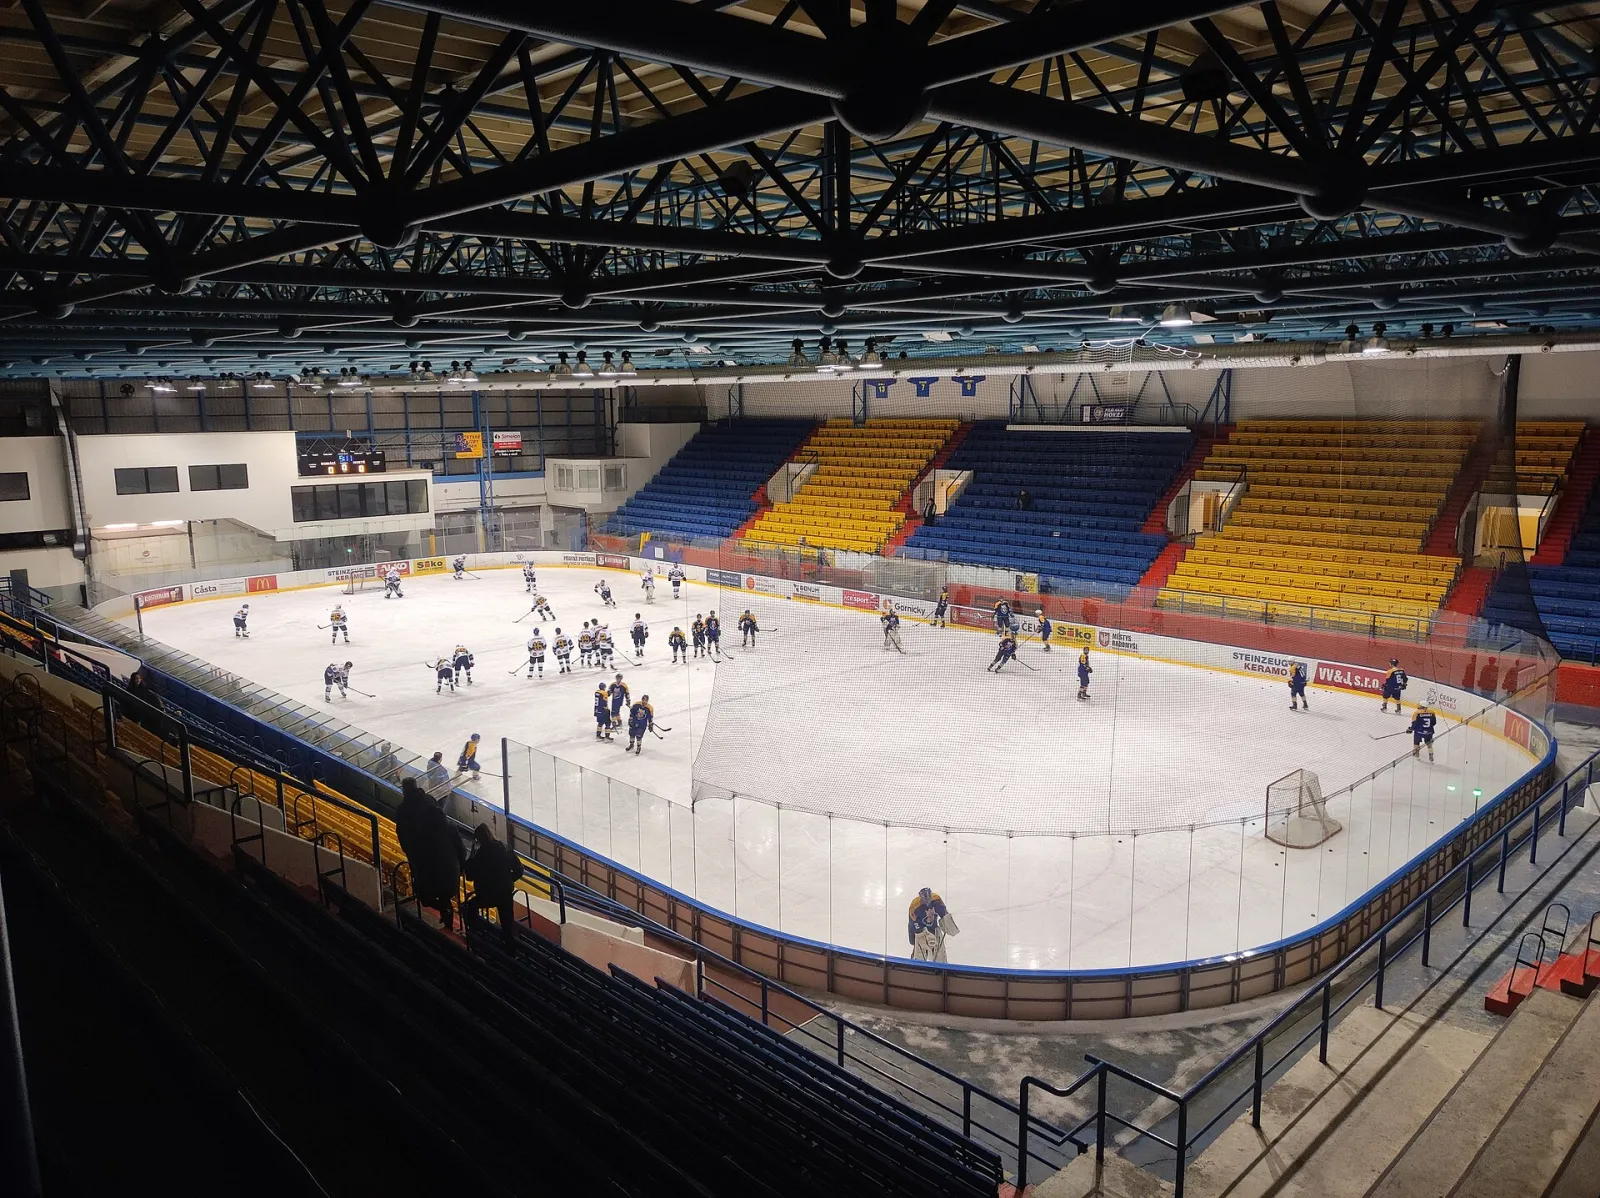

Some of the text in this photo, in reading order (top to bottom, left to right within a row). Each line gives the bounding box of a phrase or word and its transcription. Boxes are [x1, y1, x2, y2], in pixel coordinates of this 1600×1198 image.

[1232, 652, 1289, 668] STEINZEUG
[1243, 662, 1288, 677] KERAMO
[1422, 718, 1431, 728] 3
